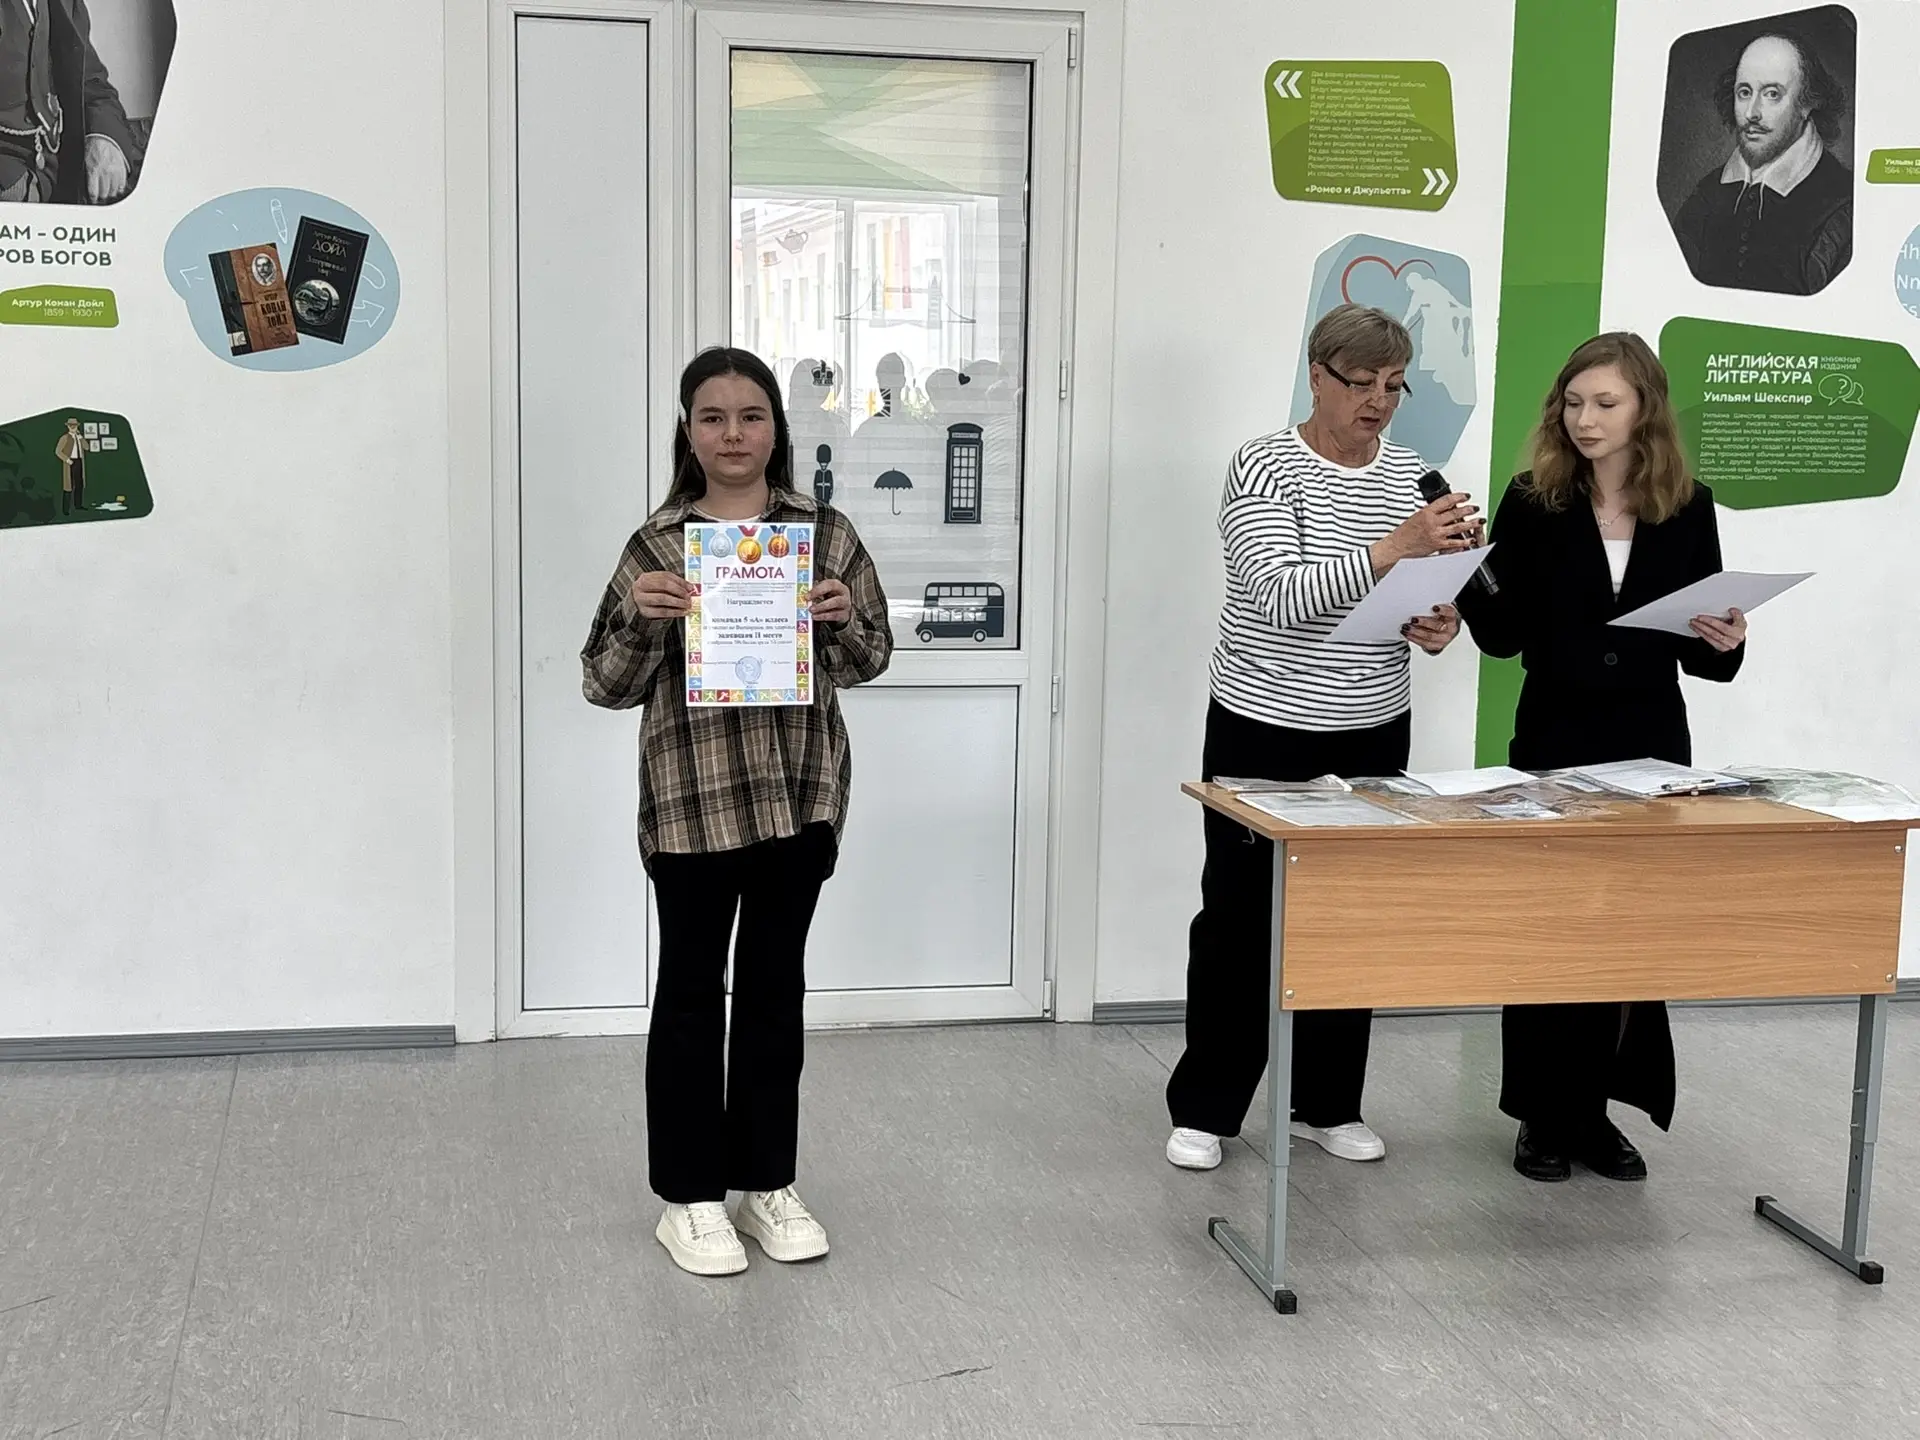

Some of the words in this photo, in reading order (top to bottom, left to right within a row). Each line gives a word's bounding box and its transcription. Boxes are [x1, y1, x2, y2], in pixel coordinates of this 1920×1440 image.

[1305, 185, 1342, 194] «Ромео
[1352, 186, 1411, 195] Джульетта»
[53, 226, 116, 244] ОДИН
[41, 250, 112, 266] БОГОВ
[12, 298, 42, 308] Артур
[45, 299, 75, 307] Конан
[78, 299, 104, 308] Дойл
[72, 309, 92, 317] 1930
[1706, 352, 1818, 368] АНГЛИЙСКАЯ
[1705, 370, 1812, 385] ЛИТЕРАТУРА
[1703, 391, 1751, 403] Уильям
[1754, 392, 1812, 405] Шекспир
[716, 566, 785, 578] ГРАМОТА
